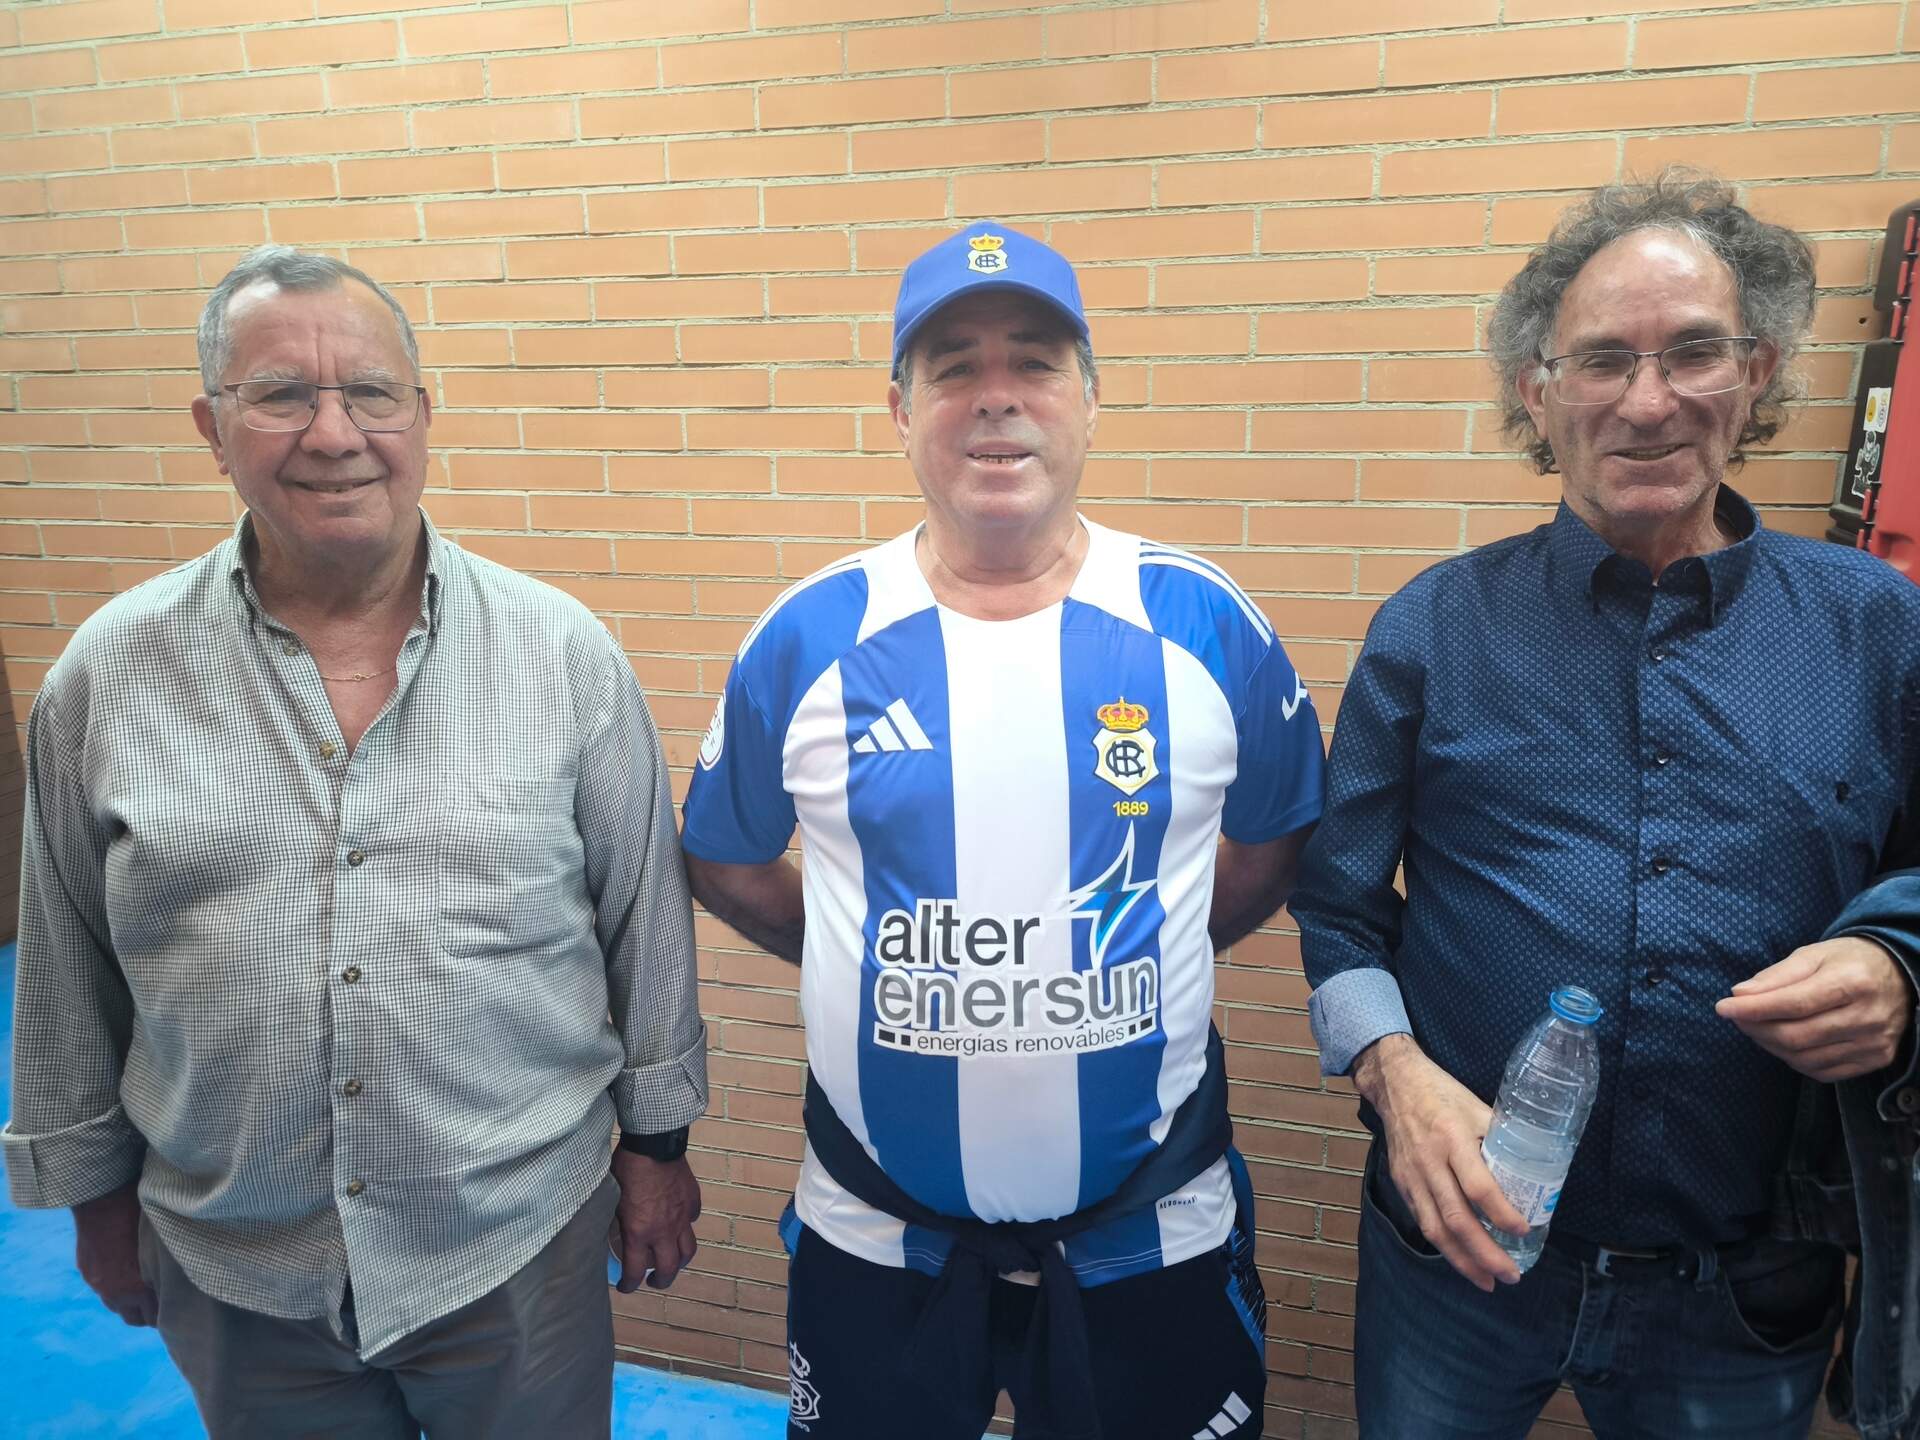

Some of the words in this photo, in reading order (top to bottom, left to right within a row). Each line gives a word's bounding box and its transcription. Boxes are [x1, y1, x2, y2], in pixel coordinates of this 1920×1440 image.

[1112, 800, 1149, 817] 1889
[878, 902, 1041, 967] alter
[877, 961, 1156, 1029] enersun
[917, 1031, 1008, 1057] energías
[1014, 1024, 1125, 1053] renovables
